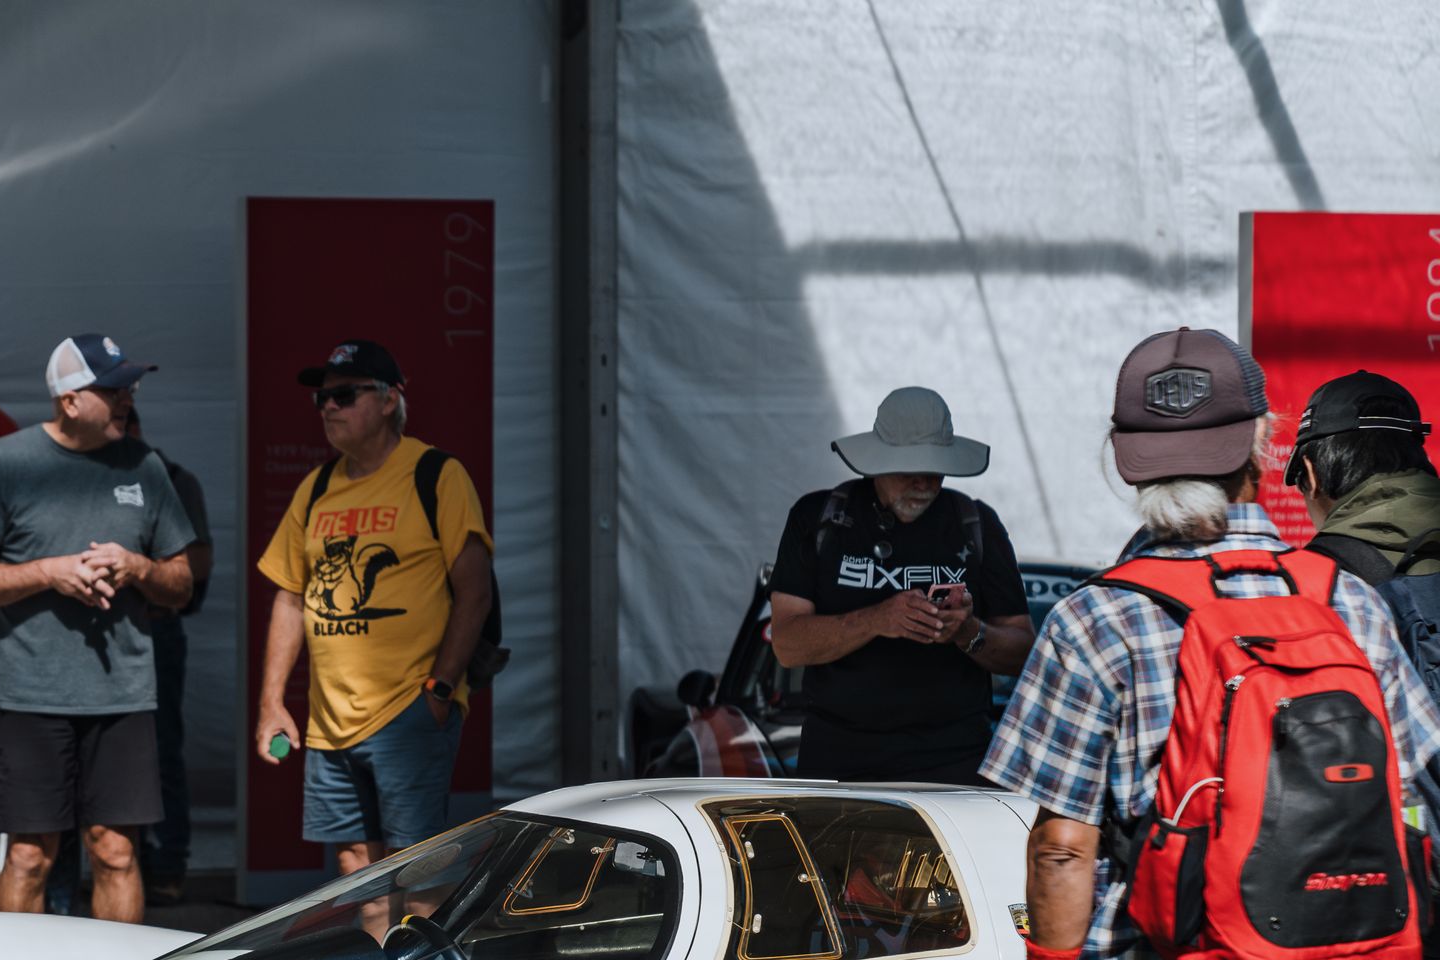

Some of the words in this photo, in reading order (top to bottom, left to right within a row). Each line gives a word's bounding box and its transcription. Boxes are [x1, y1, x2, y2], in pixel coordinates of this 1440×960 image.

[441, 211, 487, 347] 1979
[1151, 372, 1207, 408] DEUS
[313, 506, 398, 539] DEUS
[314, 621, 369, 636] BLEACH
